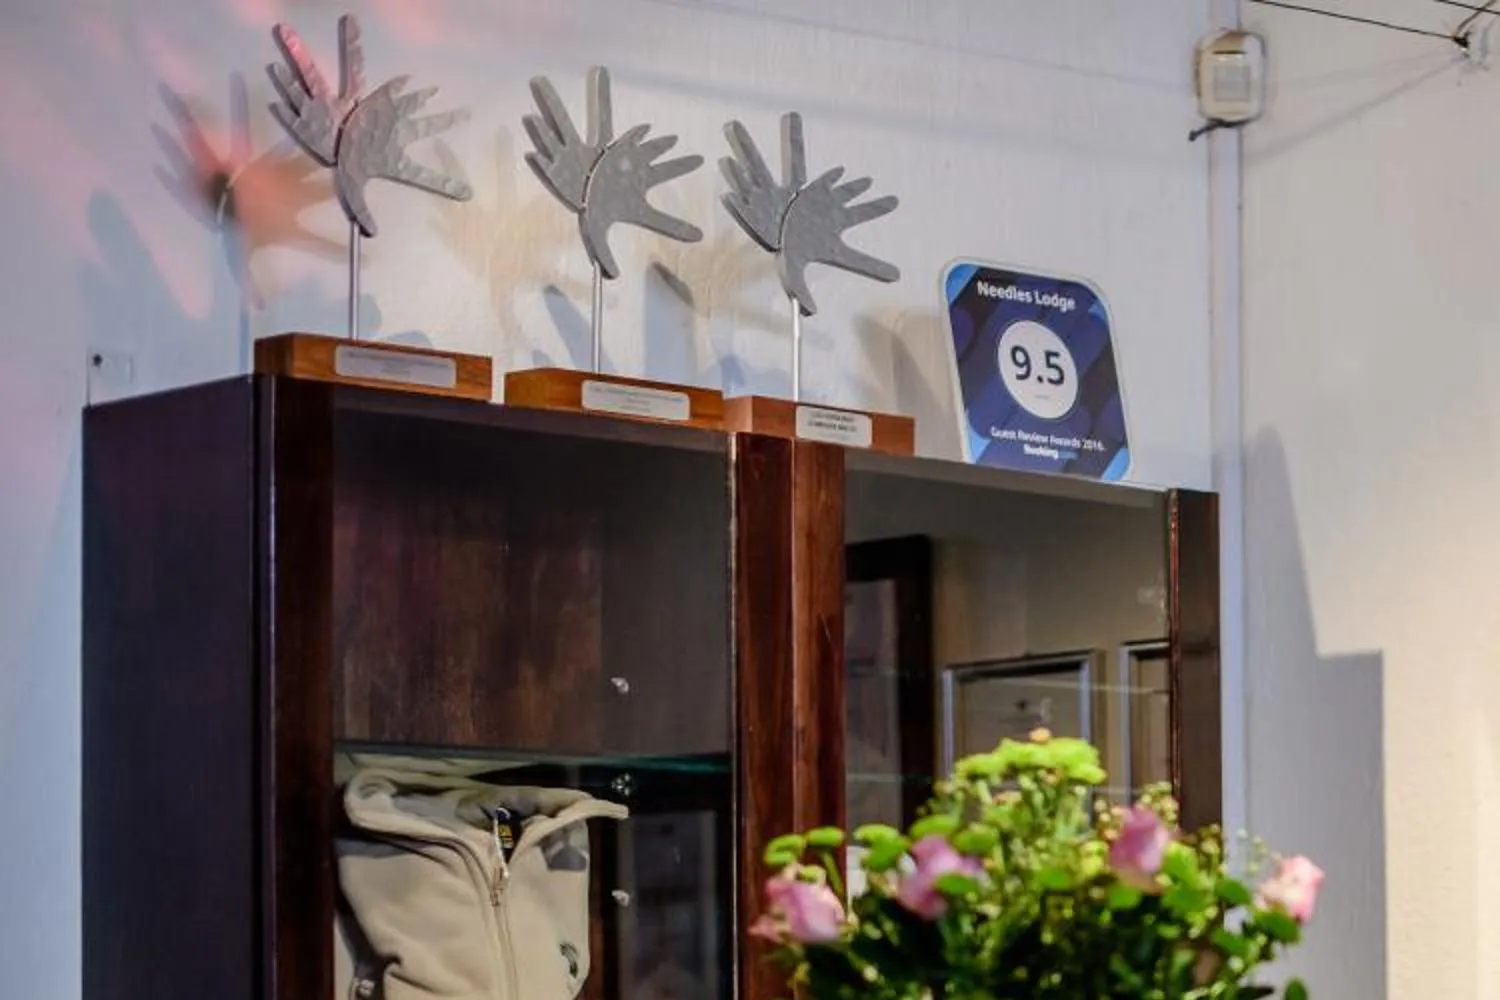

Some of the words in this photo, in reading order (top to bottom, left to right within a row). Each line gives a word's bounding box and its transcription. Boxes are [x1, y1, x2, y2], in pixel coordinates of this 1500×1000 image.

[977, 280, 1033, 303] Needles
[1034, 289, 1076, 313] Lodge
[1010, 345, 1065, 386] 9.5
